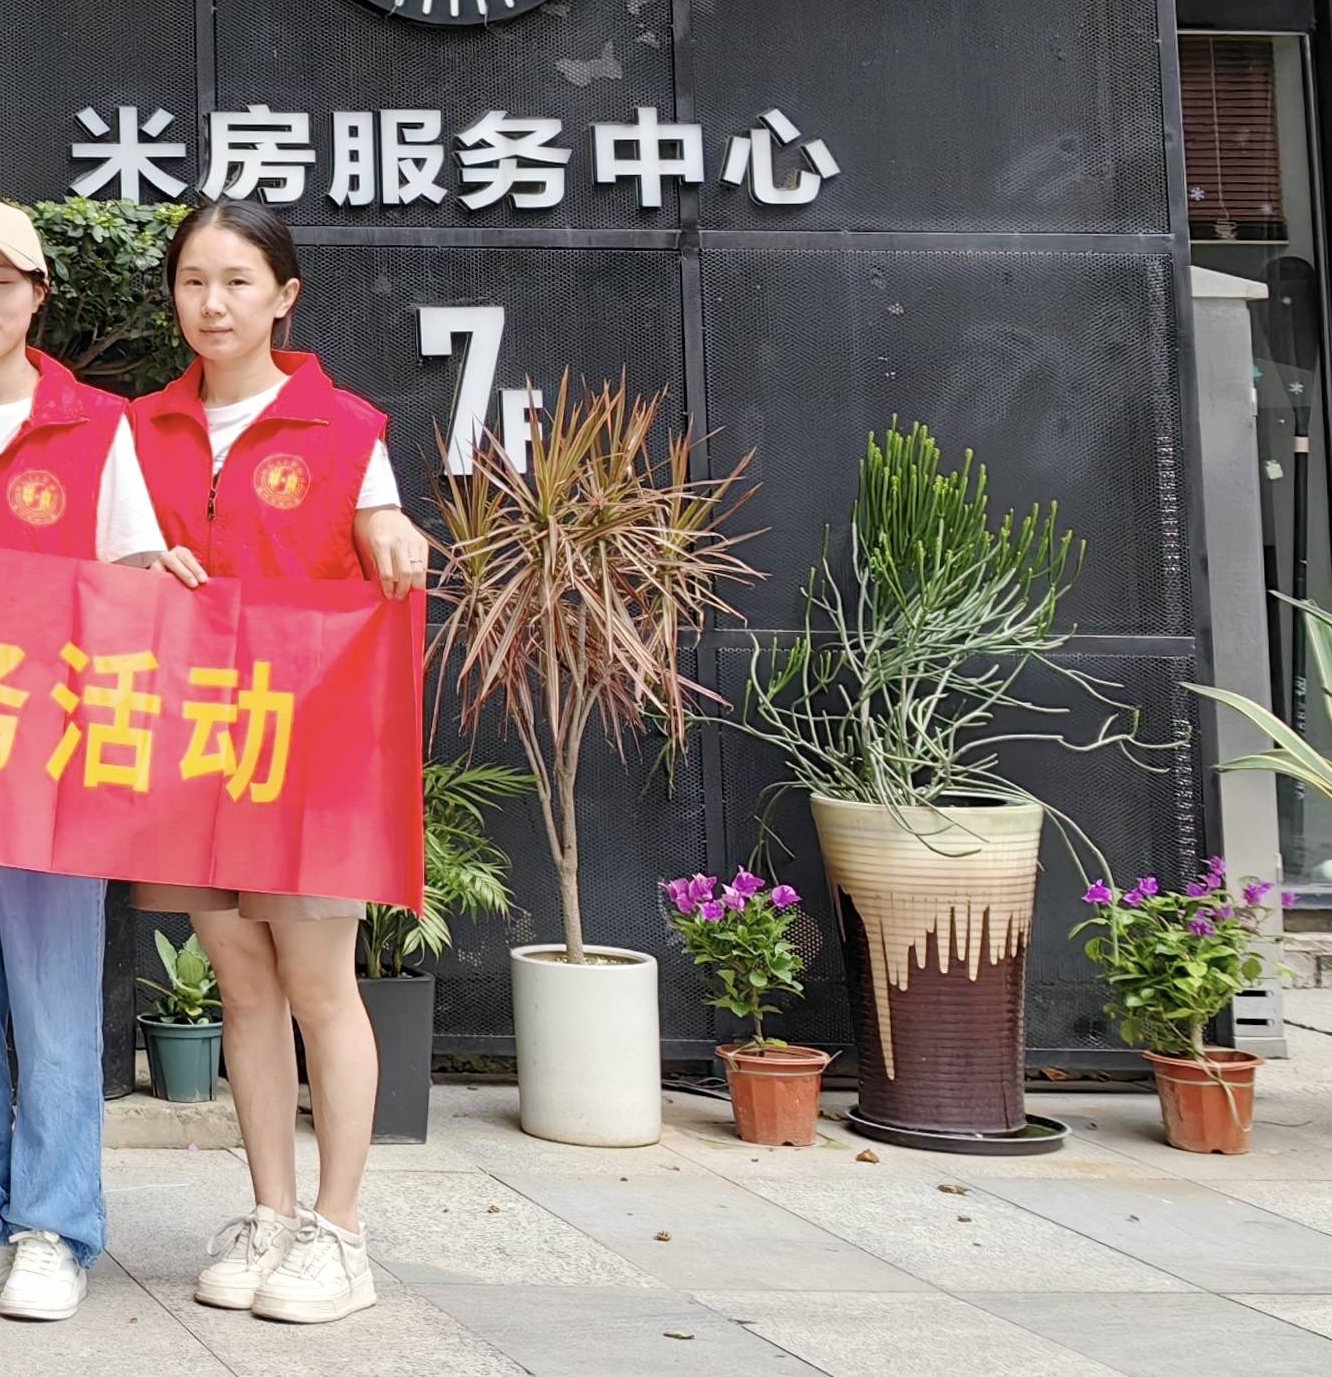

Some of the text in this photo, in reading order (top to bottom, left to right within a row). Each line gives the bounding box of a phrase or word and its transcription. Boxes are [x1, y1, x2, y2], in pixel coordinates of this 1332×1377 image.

[69, 104, 841, 210] 米房服务中心
